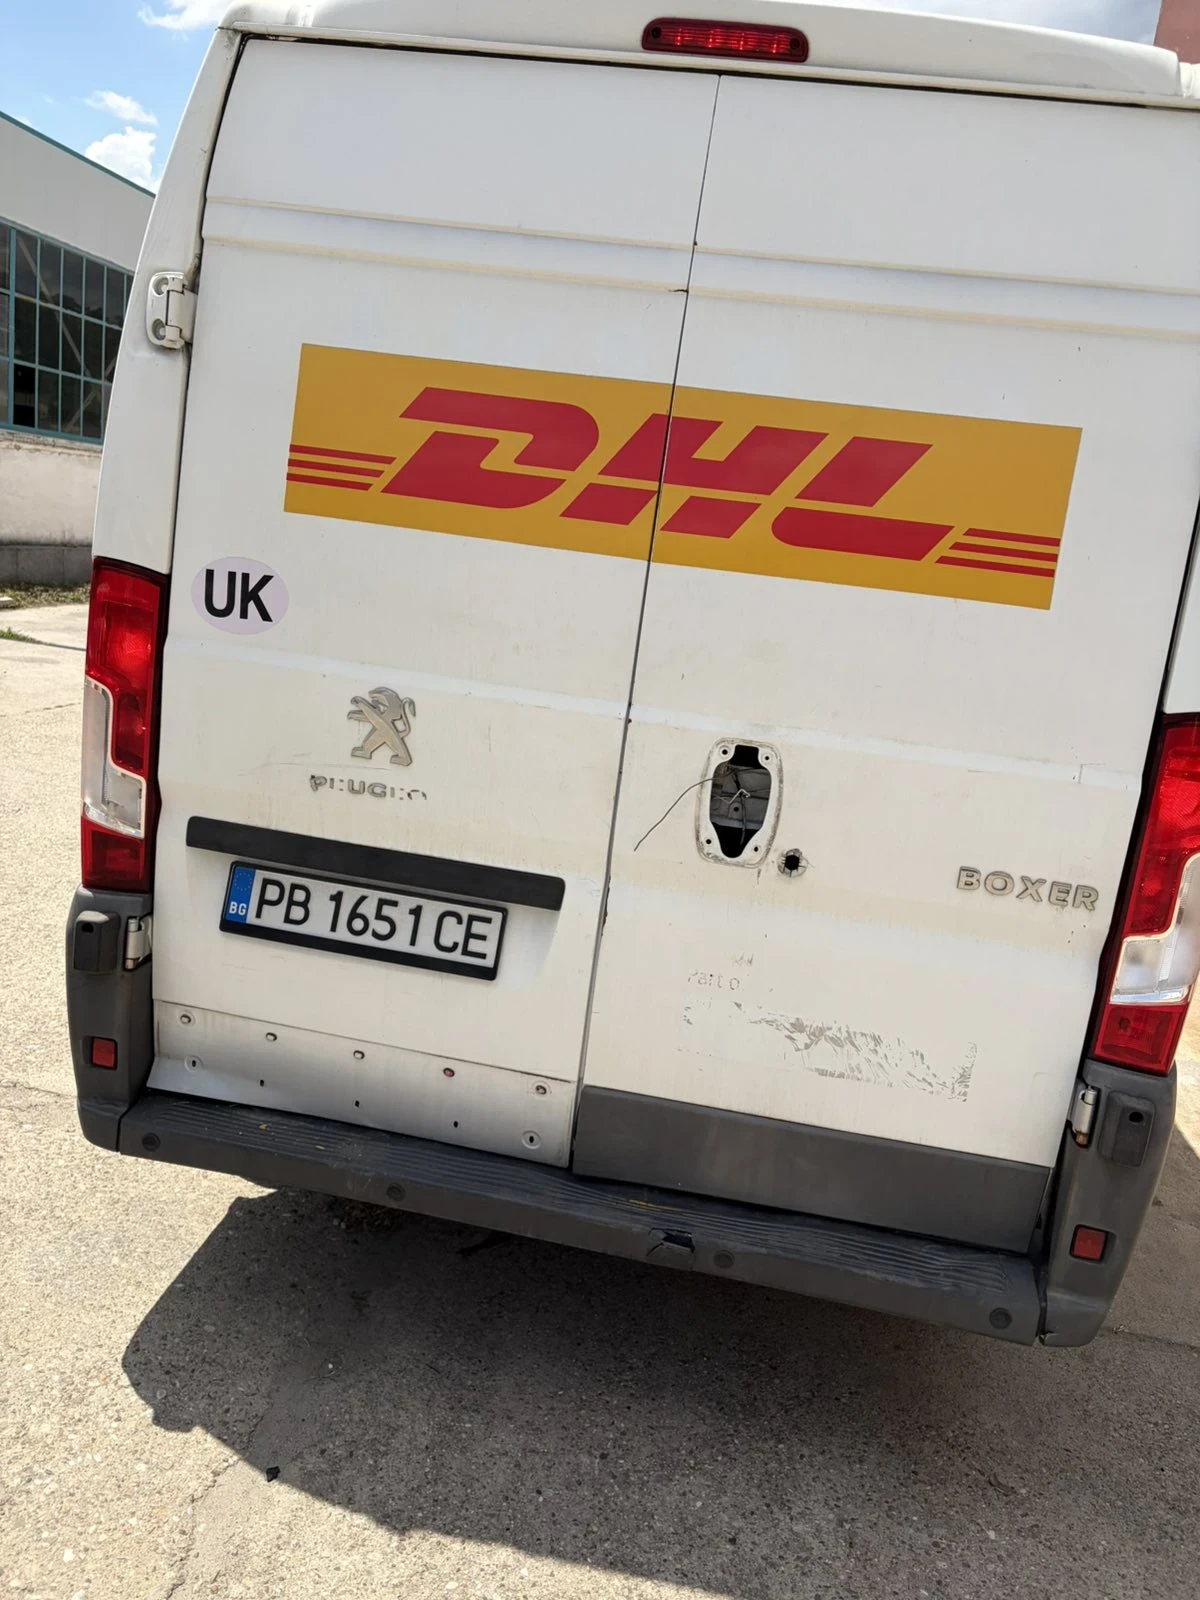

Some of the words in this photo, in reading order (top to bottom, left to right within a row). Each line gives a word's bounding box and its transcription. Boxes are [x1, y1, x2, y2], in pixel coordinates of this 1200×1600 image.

[380, 385, 955, 562] DHL
[204, 568, 275, 623] UK
[228, 901, 247, 916] BG
[956, 865, 1100, 912] BOXER
[255, 877, 311, 926] PB
[329, 889, 423, 947] 1651
[433, 910, 493, 960] CE
